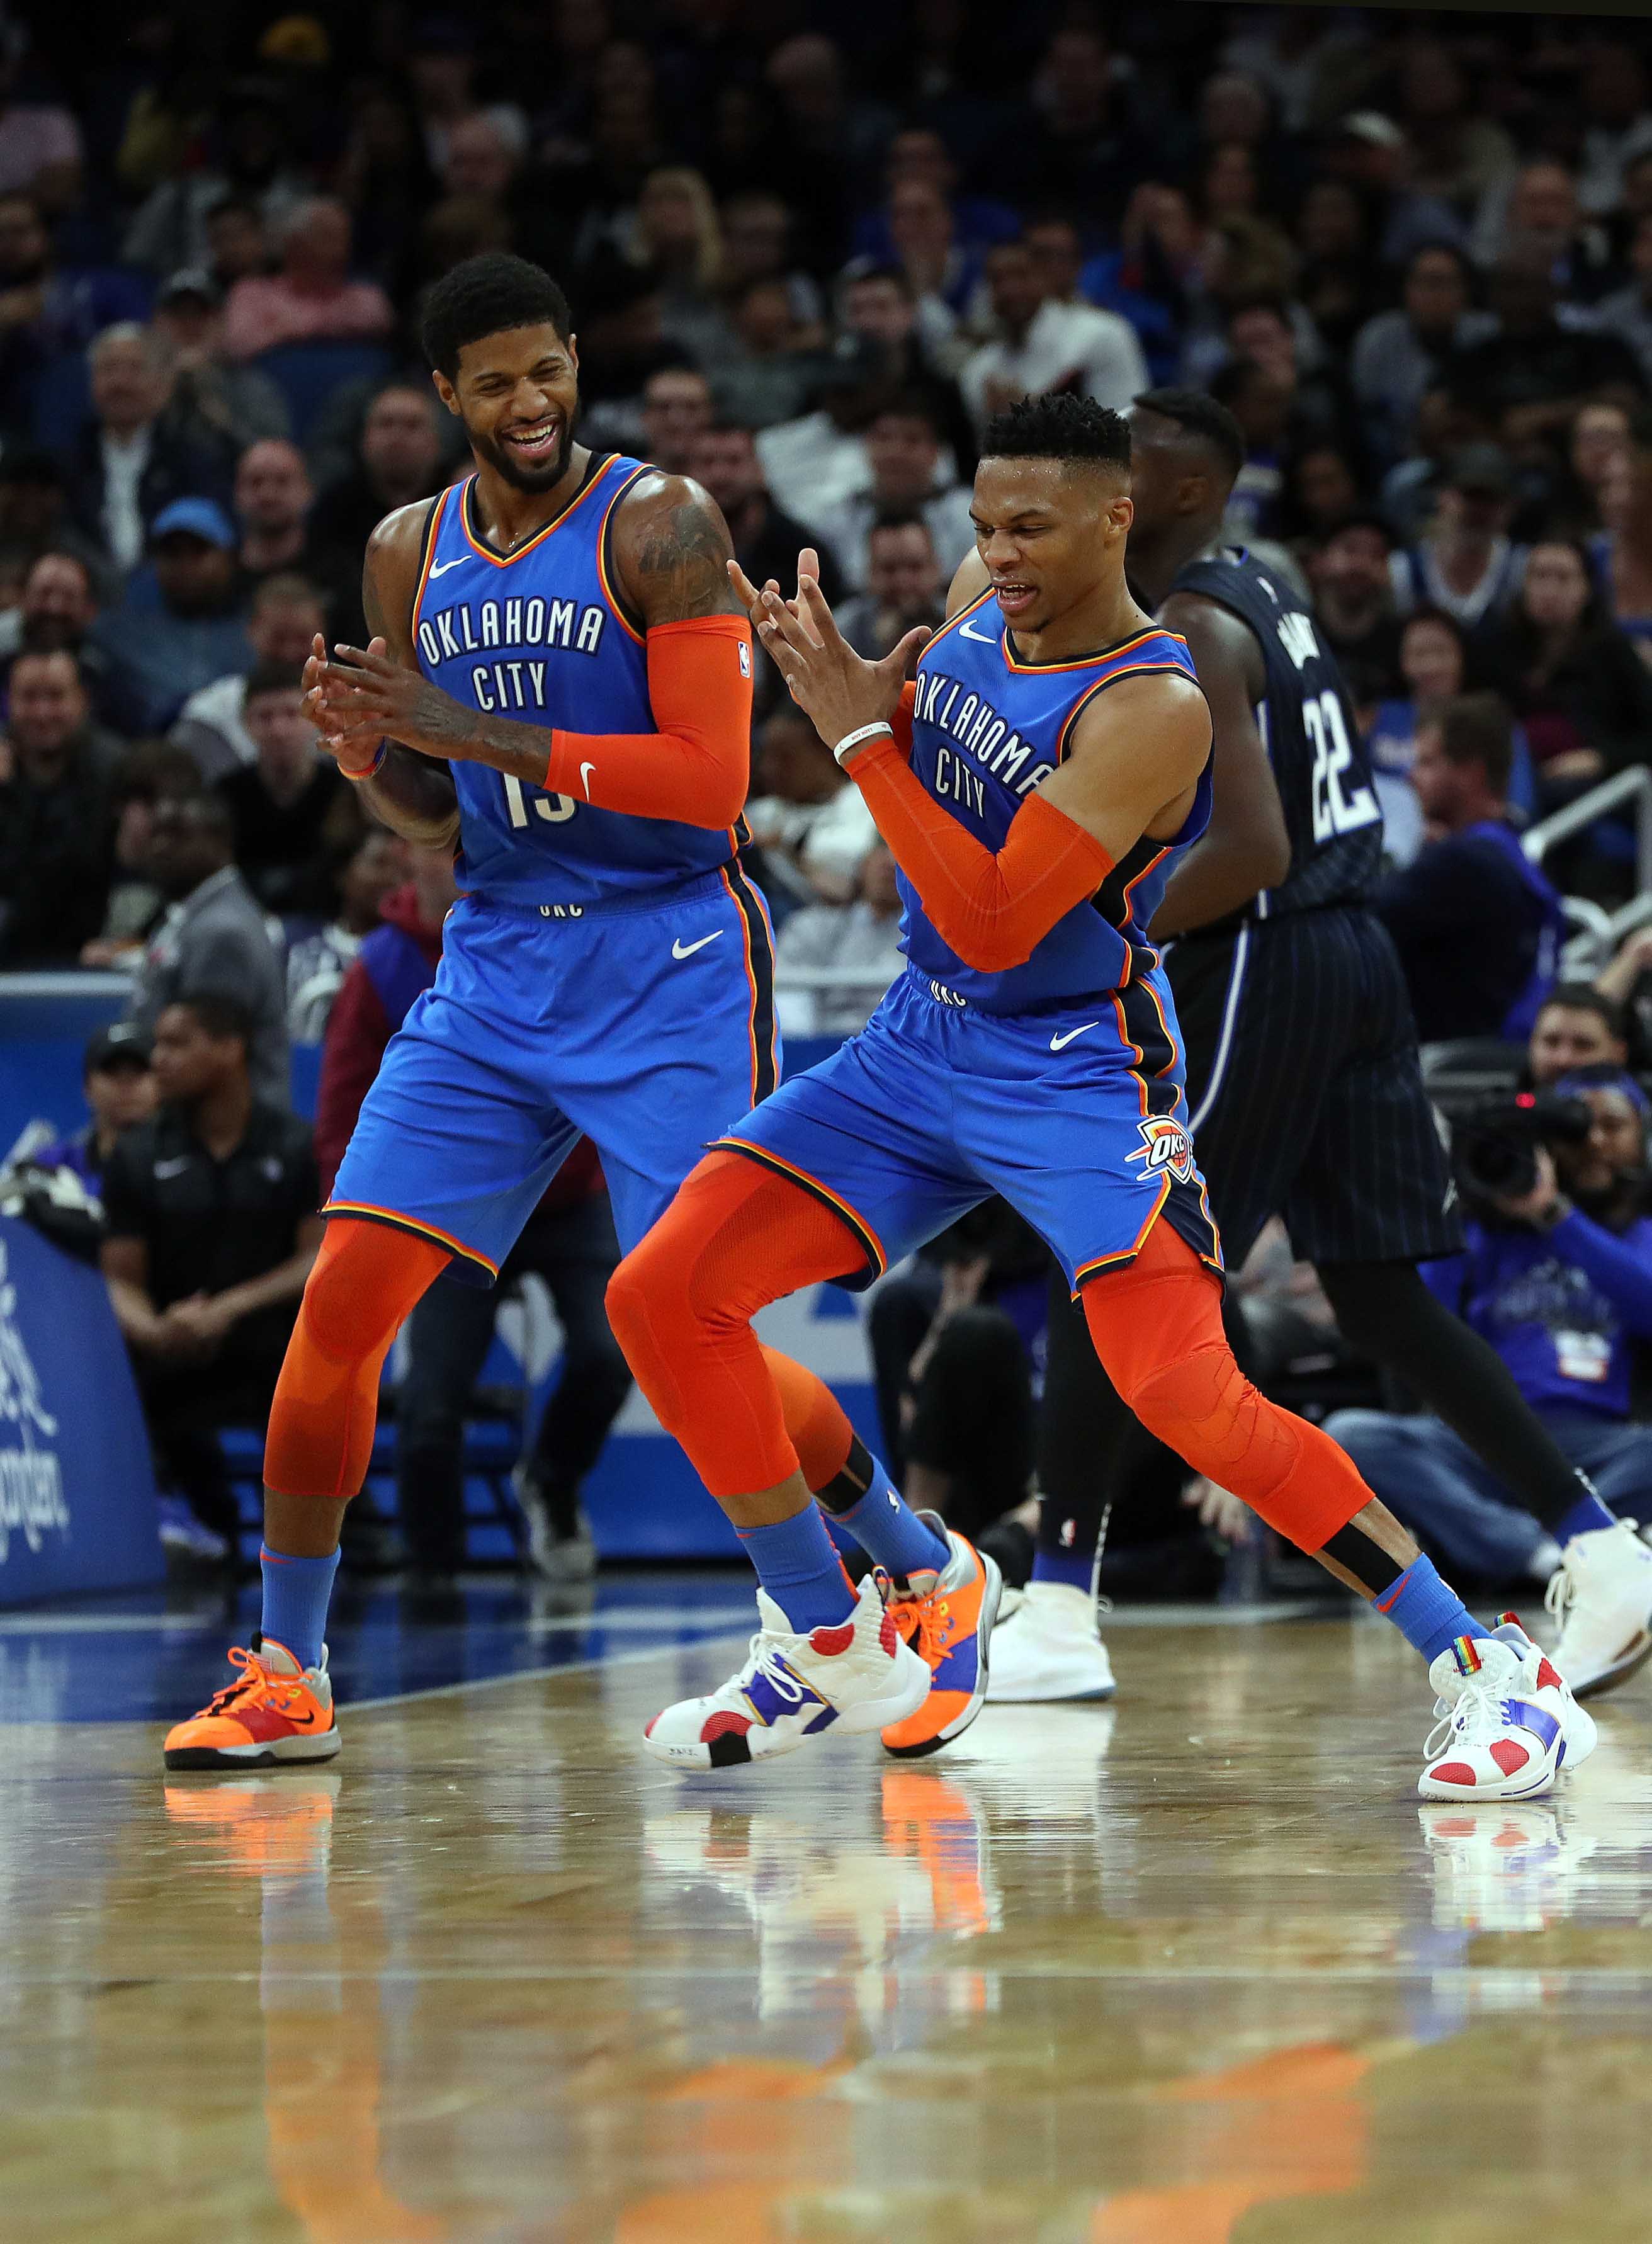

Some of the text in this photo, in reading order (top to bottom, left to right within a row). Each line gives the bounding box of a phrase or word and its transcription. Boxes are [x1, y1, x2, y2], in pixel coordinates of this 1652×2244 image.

[418, 598, 605, 666] OKLAHOMA
[472, 661, 545, 711] CITY
[914, 671, 1056, 795] OKLAHOMA
[1302, 689, 1381, 843] 22
[935, 747, 985, 819] CITY
[1150, 1133, 1185, 1165] OKC
